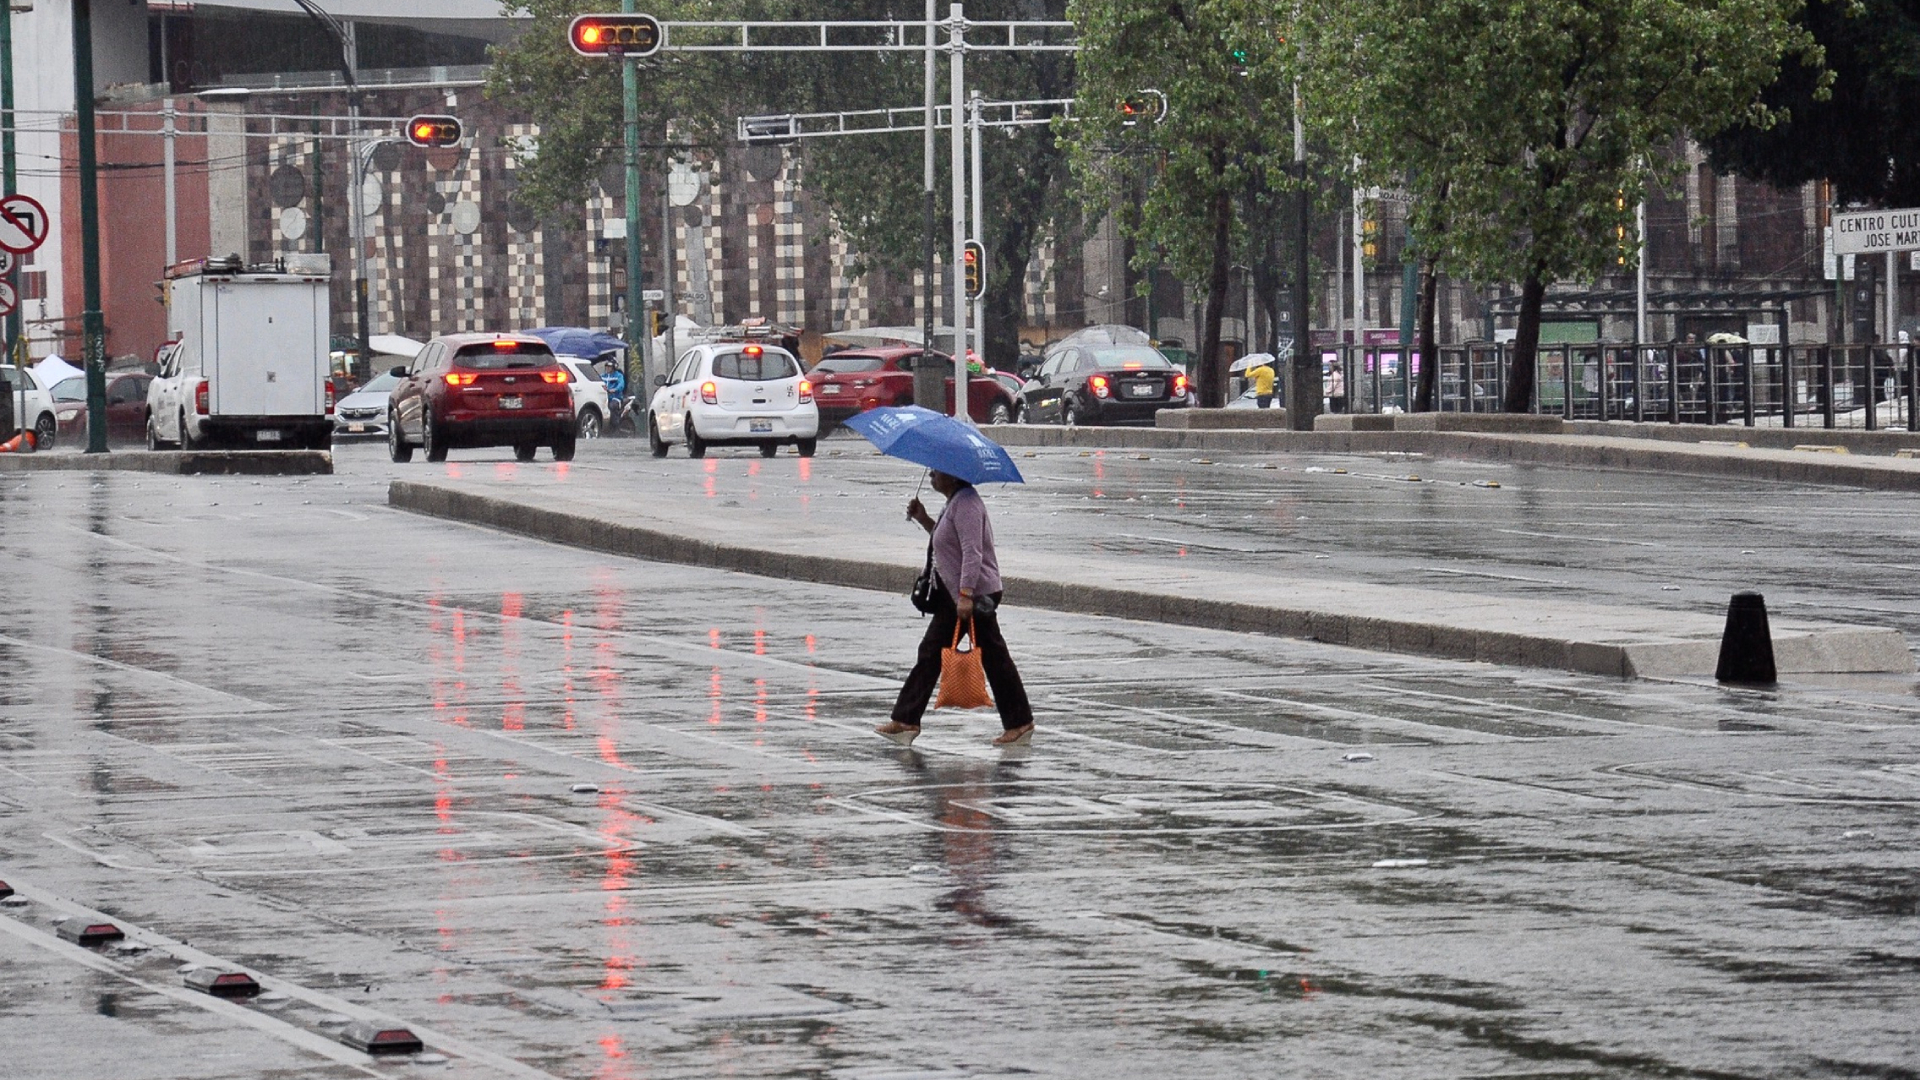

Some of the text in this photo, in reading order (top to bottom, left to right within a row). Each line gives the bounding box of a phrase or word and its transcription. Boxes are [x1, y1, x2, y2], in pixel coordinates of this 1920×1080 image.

[1378, 191, 1415, 202] IDALGO
[1840, 214, 1918, 233] CENTRO CULT
[1864, 233, 1890, 248] JOSE
